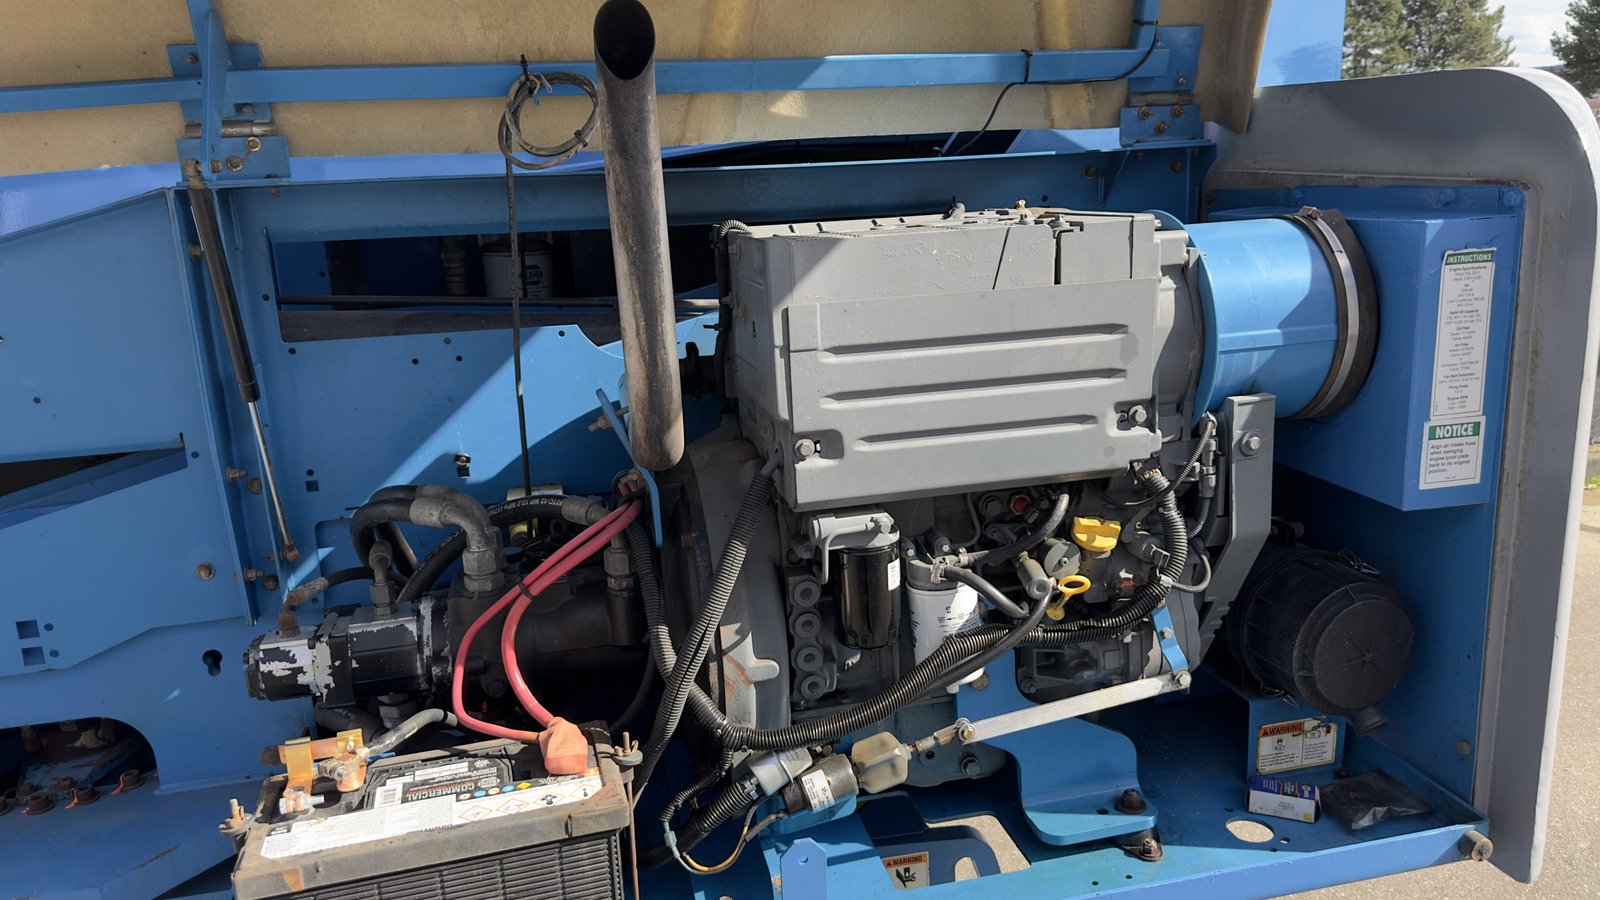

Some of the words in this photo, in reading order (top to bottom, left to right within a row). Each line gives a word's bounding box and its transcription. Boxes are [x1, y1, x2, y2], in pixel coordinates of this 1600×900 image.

[1447, 254, 1492, 264] INSTRUCTIONS
[1435, 424, 1474, 438] NOTICE
[1268, 723, 1302, 736] WARNING
[405, 783, 475, 801] COMMERCIAL
[892, 856, 922, 865] WARNING
